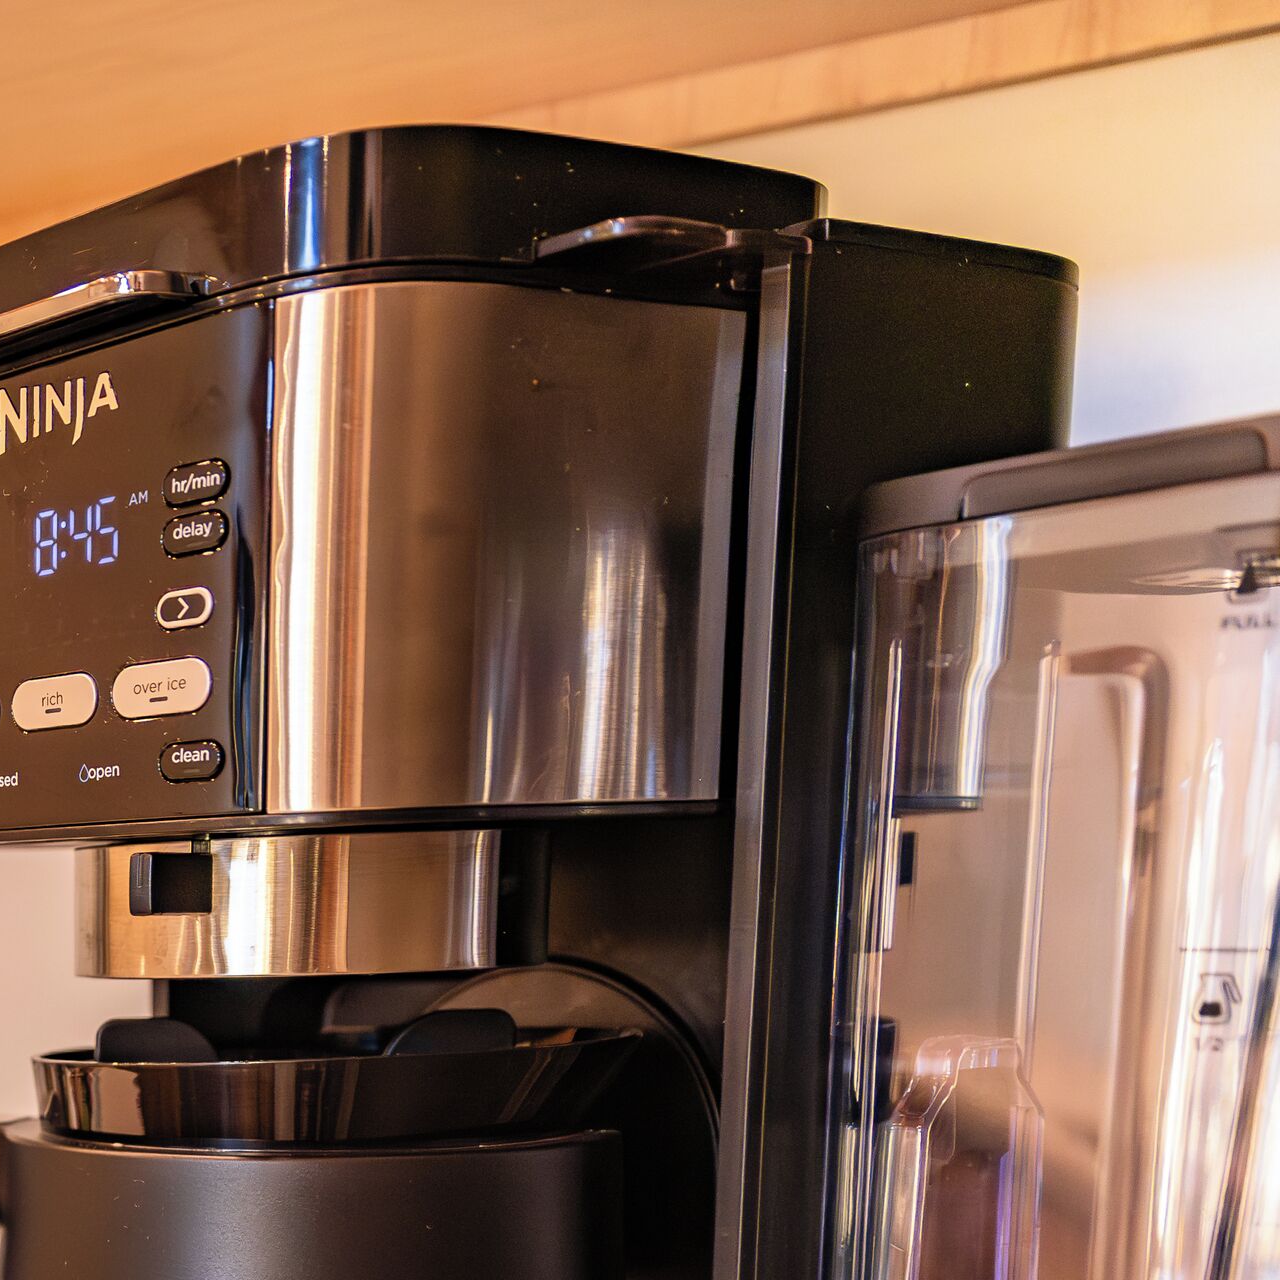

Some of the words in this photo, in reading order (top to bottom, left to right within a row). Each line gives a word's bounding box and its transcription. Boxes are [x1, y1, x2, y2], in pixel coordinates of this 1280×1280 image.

[170, 472, 221, 495] hr/min
[35, 496, 119, 577] 8:45
[128, 490, 149, 507] AM
[172, 520, 213, 541] delay
[133, 680, 163, 695] over
[167, 676, 187, 692] ice
[41, 691, 64, 708] rich
[171, 747, 210, 764] clean
[88, 763, 120, 782] open
